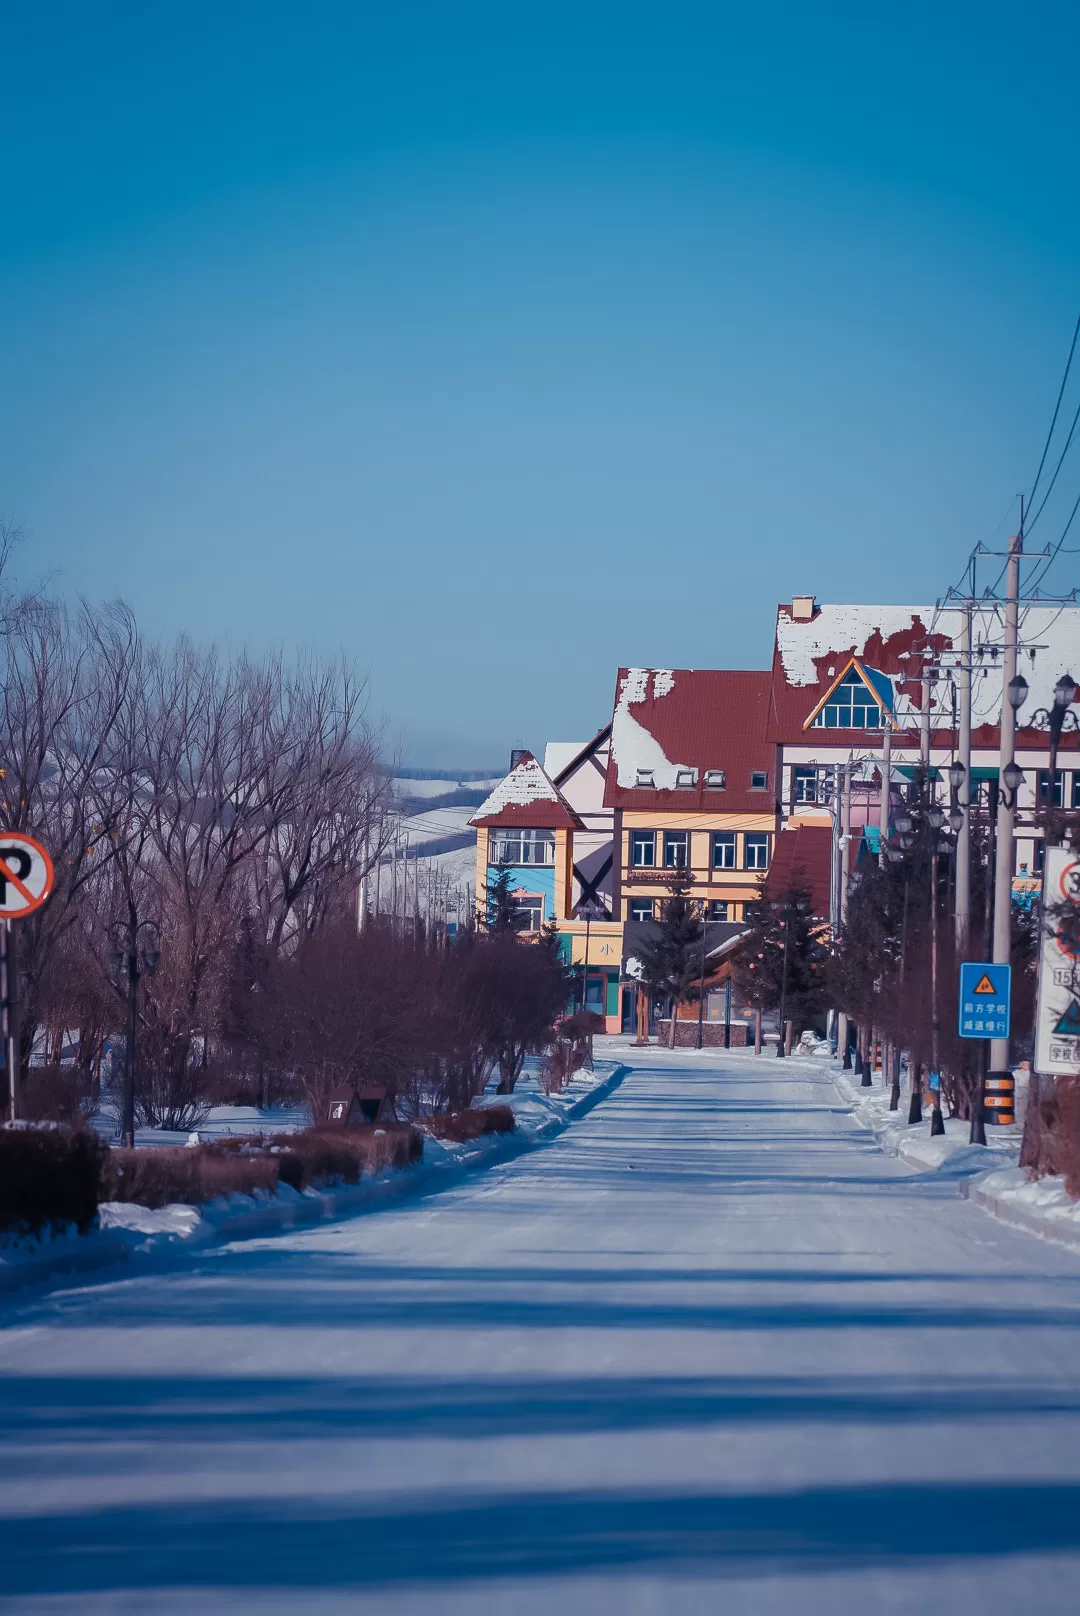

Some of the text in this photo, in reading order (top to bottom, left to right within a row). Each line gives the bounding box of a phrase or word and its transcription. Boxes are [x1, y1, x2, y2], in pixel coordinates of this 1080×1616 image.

[0, 848, 32, 905] P
[964, 1002, 1006, 1015] 前方学校
